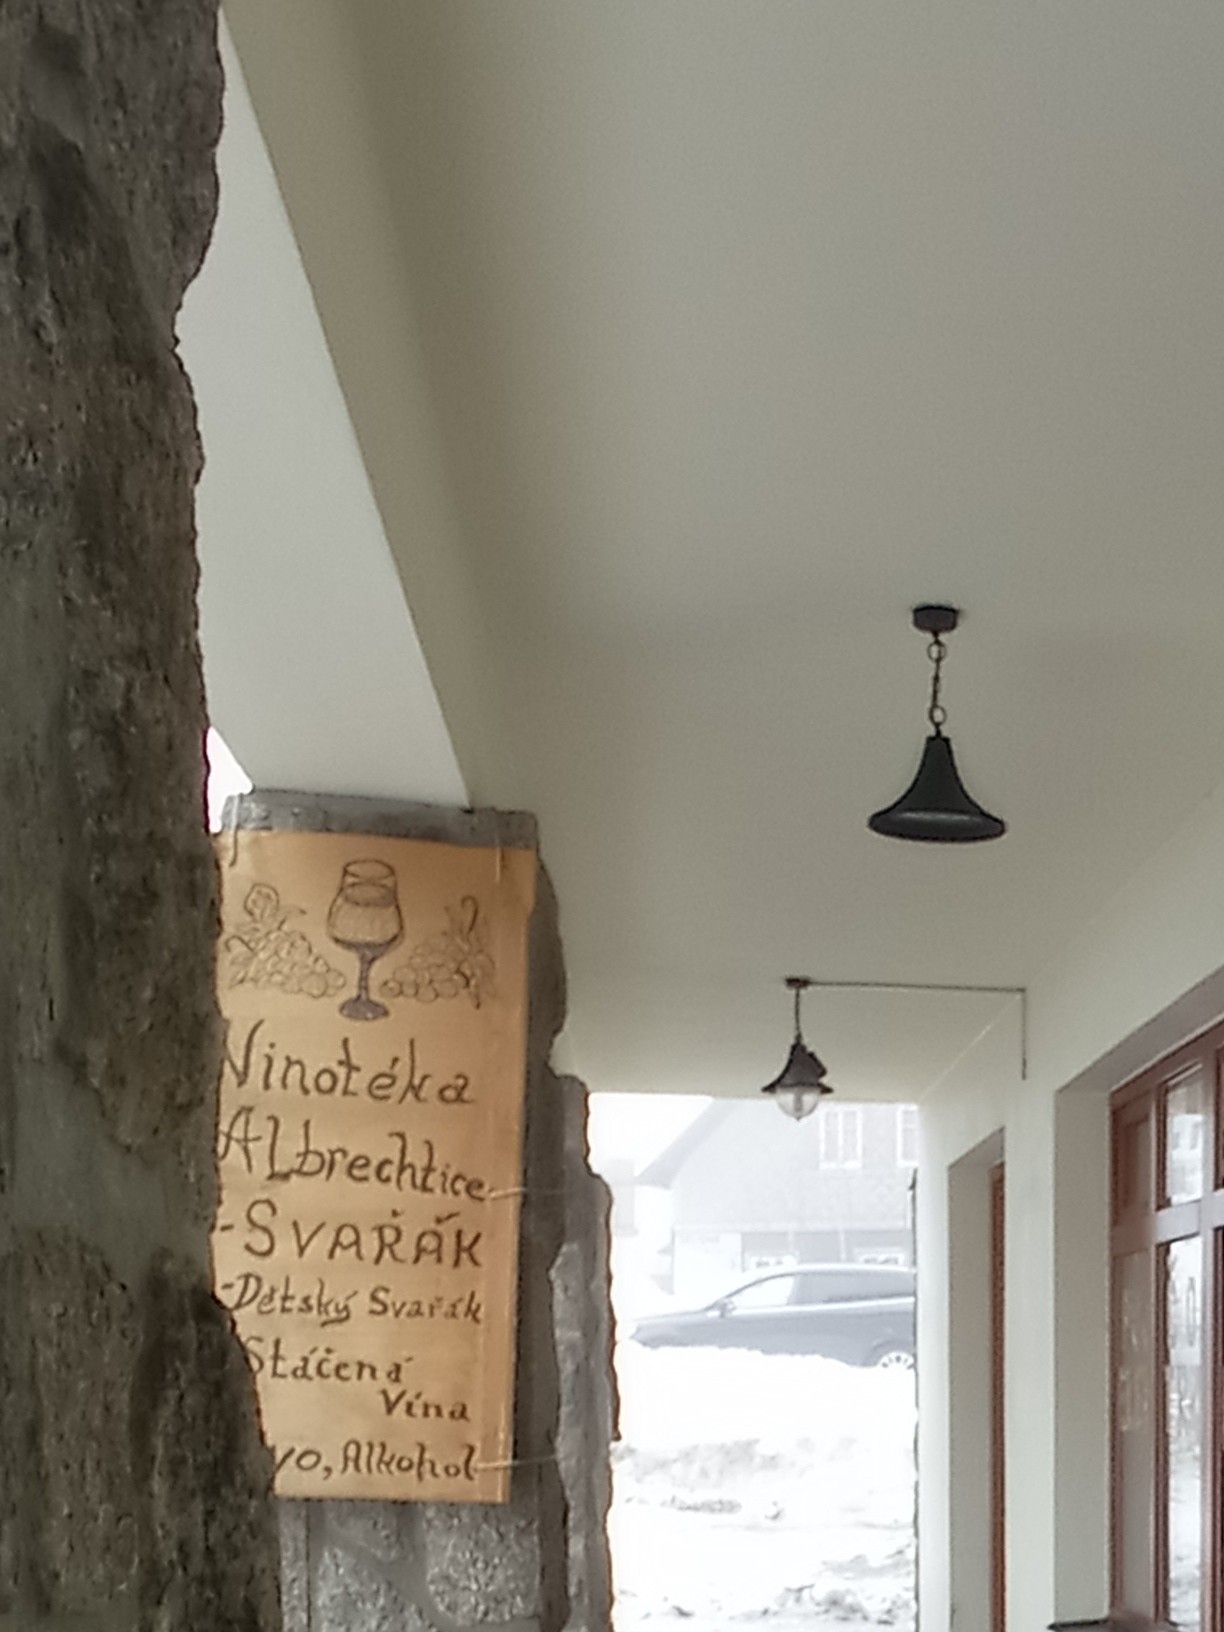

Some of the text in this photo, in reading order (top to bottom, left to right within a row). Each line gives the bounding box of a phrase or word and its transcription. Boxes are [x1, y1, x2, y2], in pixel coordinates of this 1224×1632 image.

[227, 1018, 473, 1104] Vinotéka
[218, 1105, 488, 1202] Albrechtice
[245, 1335, 414, 1384] Stáčená
[341, 1439, 479, 1484] Alkohol
